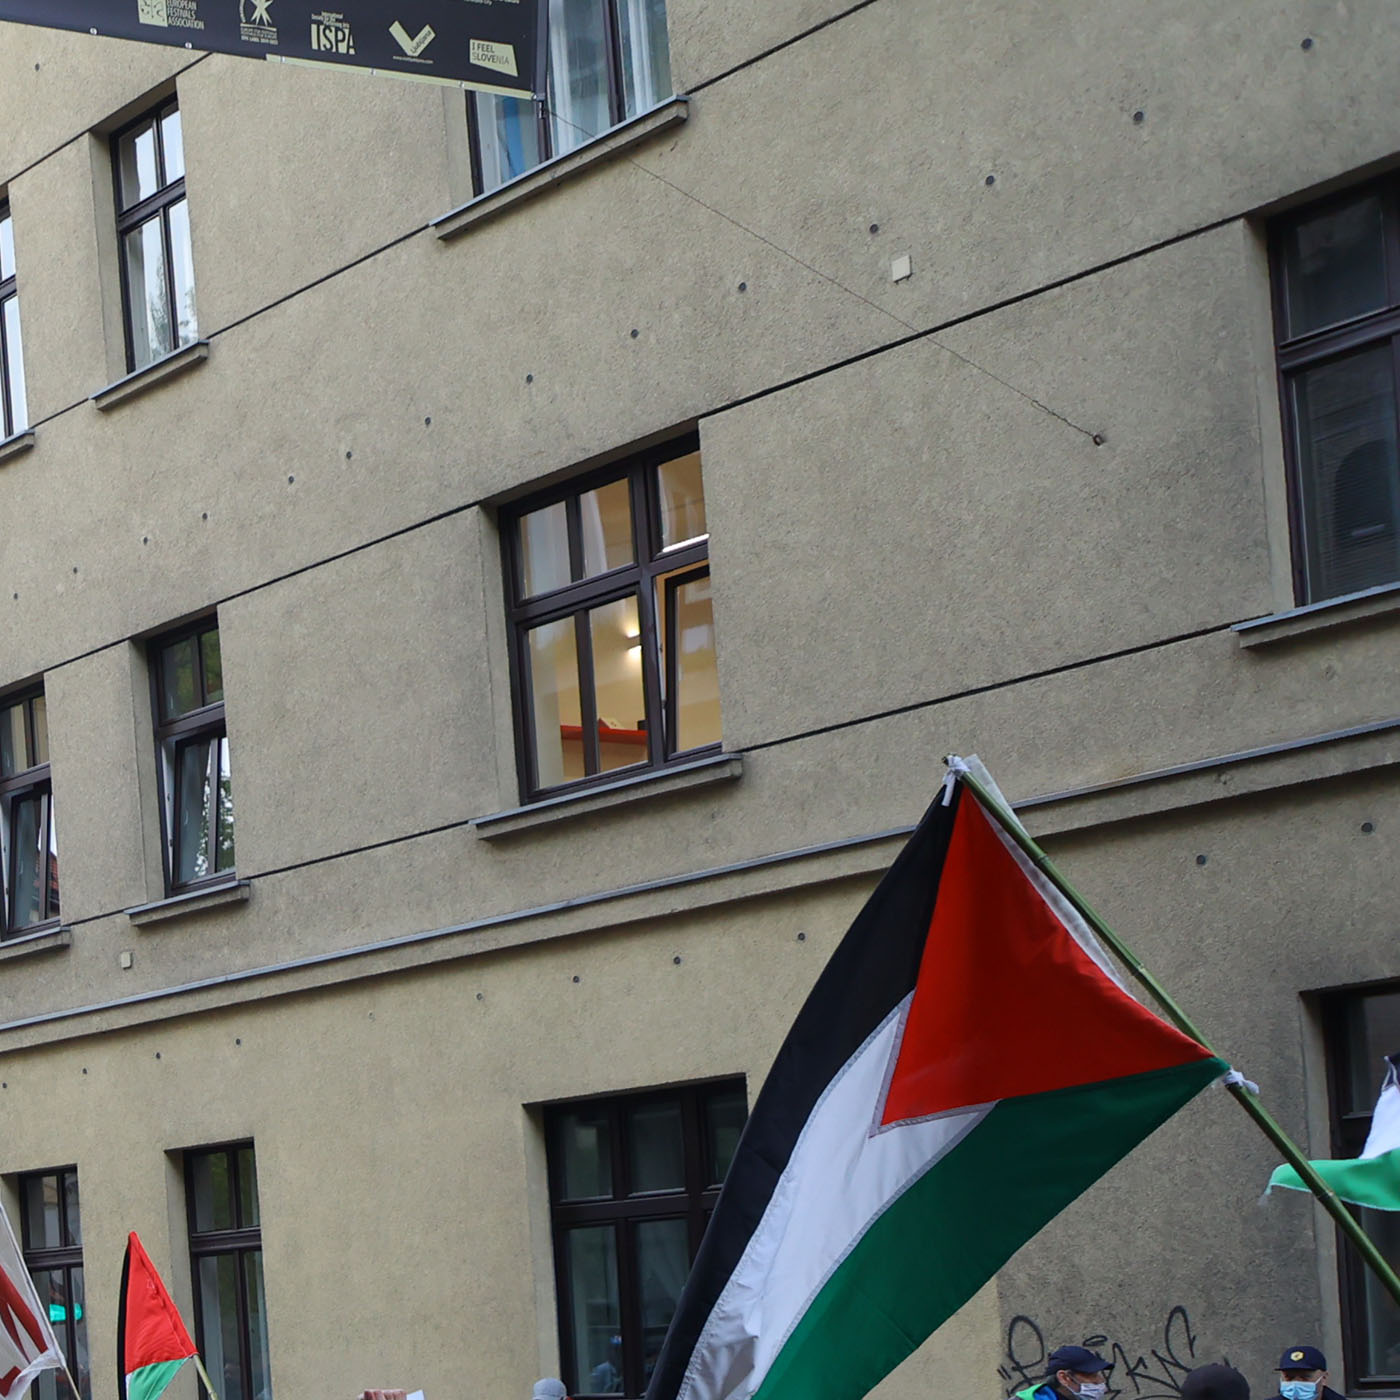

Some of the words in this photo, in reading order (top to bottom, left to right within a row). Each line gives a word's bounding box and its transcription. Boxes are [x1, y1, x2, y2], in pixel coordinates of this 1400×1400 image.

[168, 18, 205, 30] ASSOCIATION
[477, 43, 495, 53] FEEL
[472, 52, 510, 65] SLOVENIA
